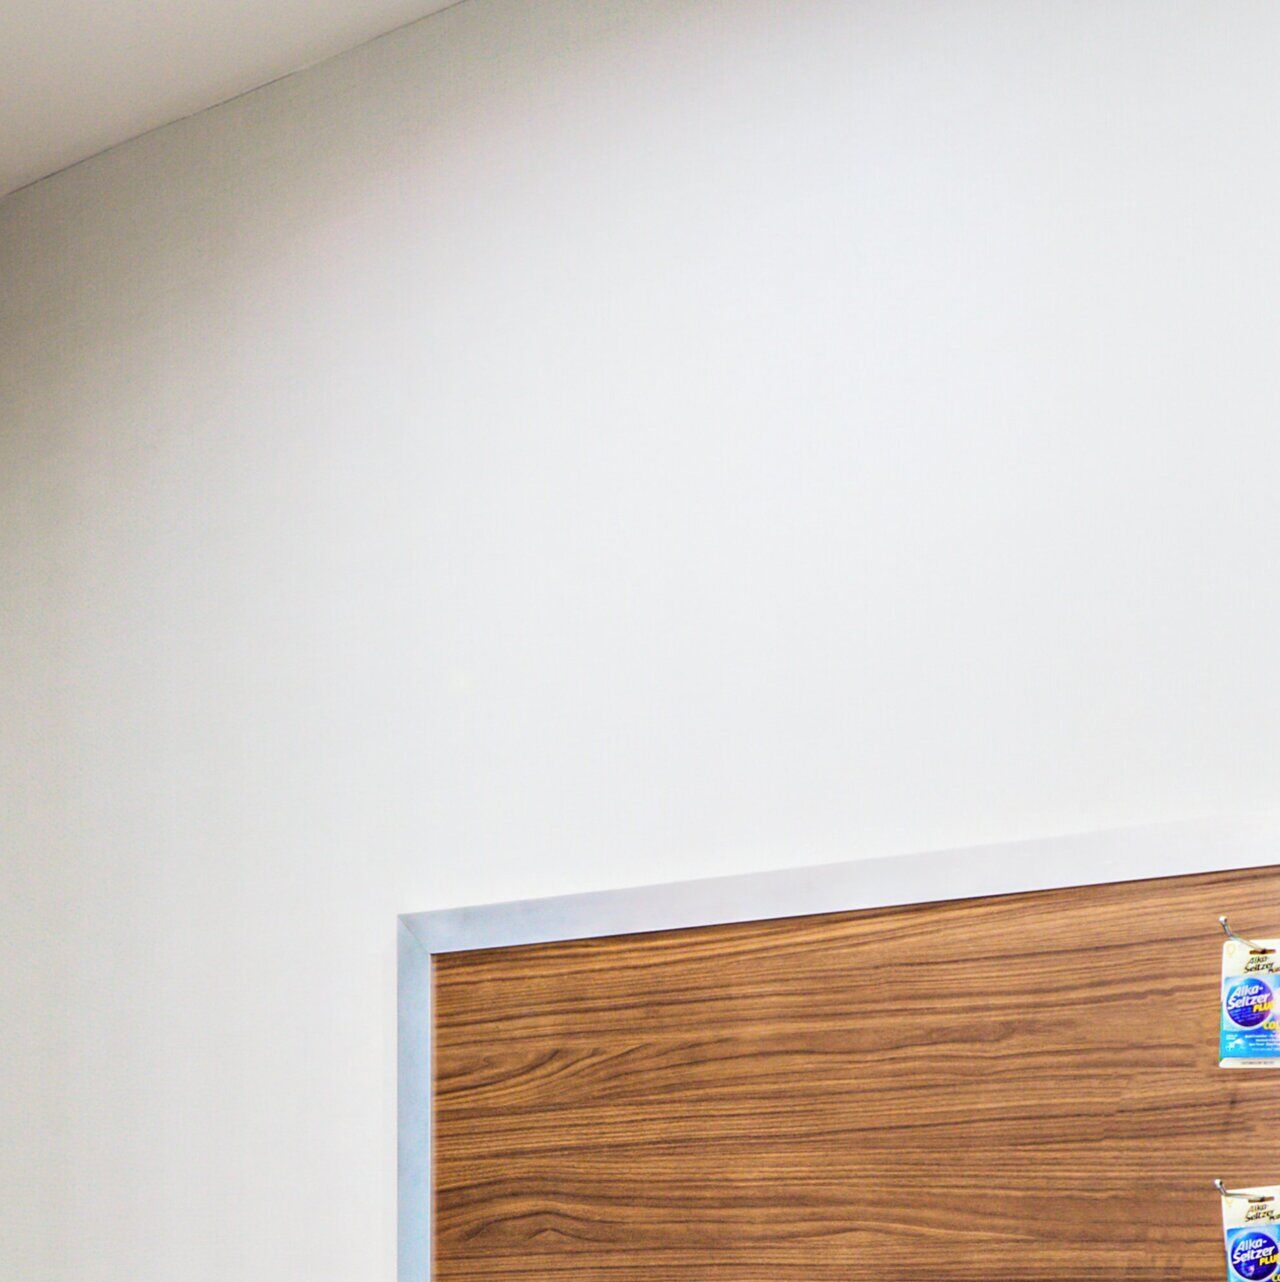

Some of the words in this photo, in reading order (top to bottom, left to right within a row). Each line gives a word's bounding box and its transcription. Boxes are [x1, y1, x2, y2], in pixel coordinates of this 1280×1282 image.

[1234, 984, 1263, 997] Alka-
[1228, 992, 1270, 1009] Seltzer
[1235, 1239, 1267, 1252] Alka-
[1232, 1246, 1276, 1265] Seltzer
